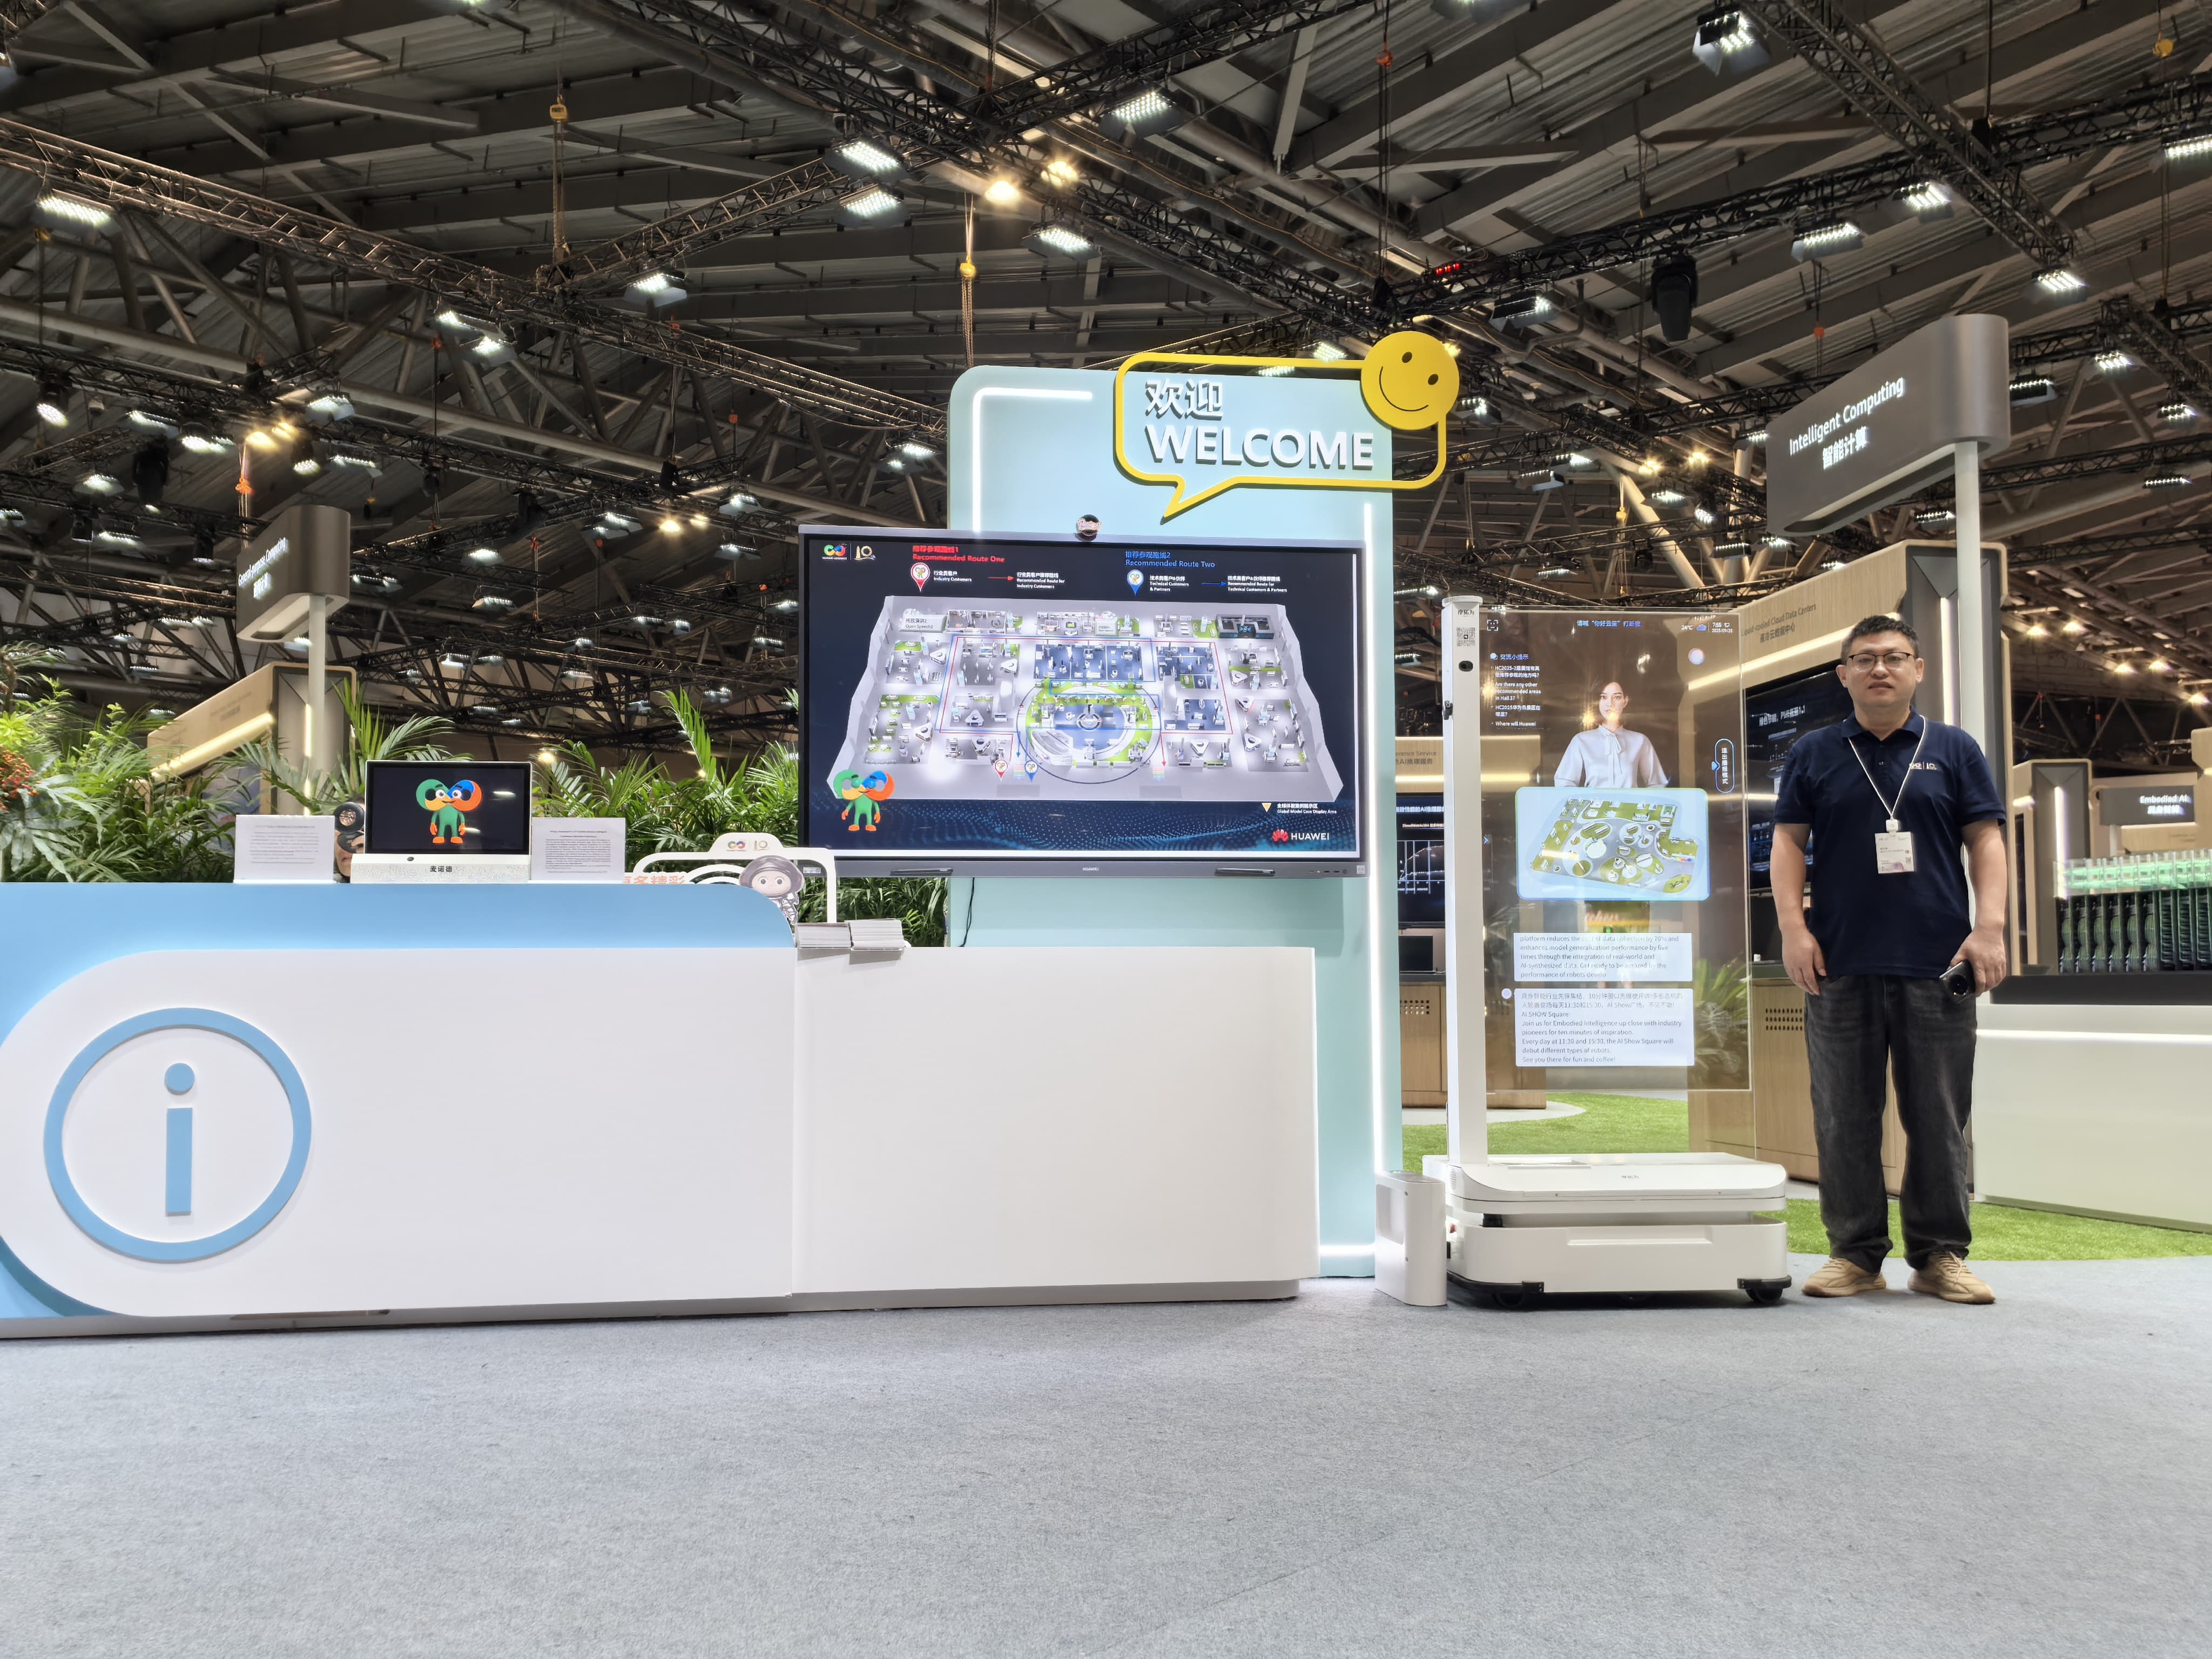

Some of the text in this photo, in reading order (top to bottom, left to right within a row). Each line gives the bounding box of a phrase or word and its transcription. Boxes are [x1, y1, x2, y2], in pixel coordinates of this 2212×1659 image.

[1145, 379, 1223, 420] 欢迎
[1789, 376, 1905, 456] Intelligent Computing
[1145, 424, 1374, 470] WELCOME
[1822, 426, 1868, 471] 智能计算
[913, 554, 966, 562] Recommended
[1785, 610, 1797, 620] Data
[1798, 604, 1816, 615] Centers
[2140, 794, 2188, 804] Embodied AI
